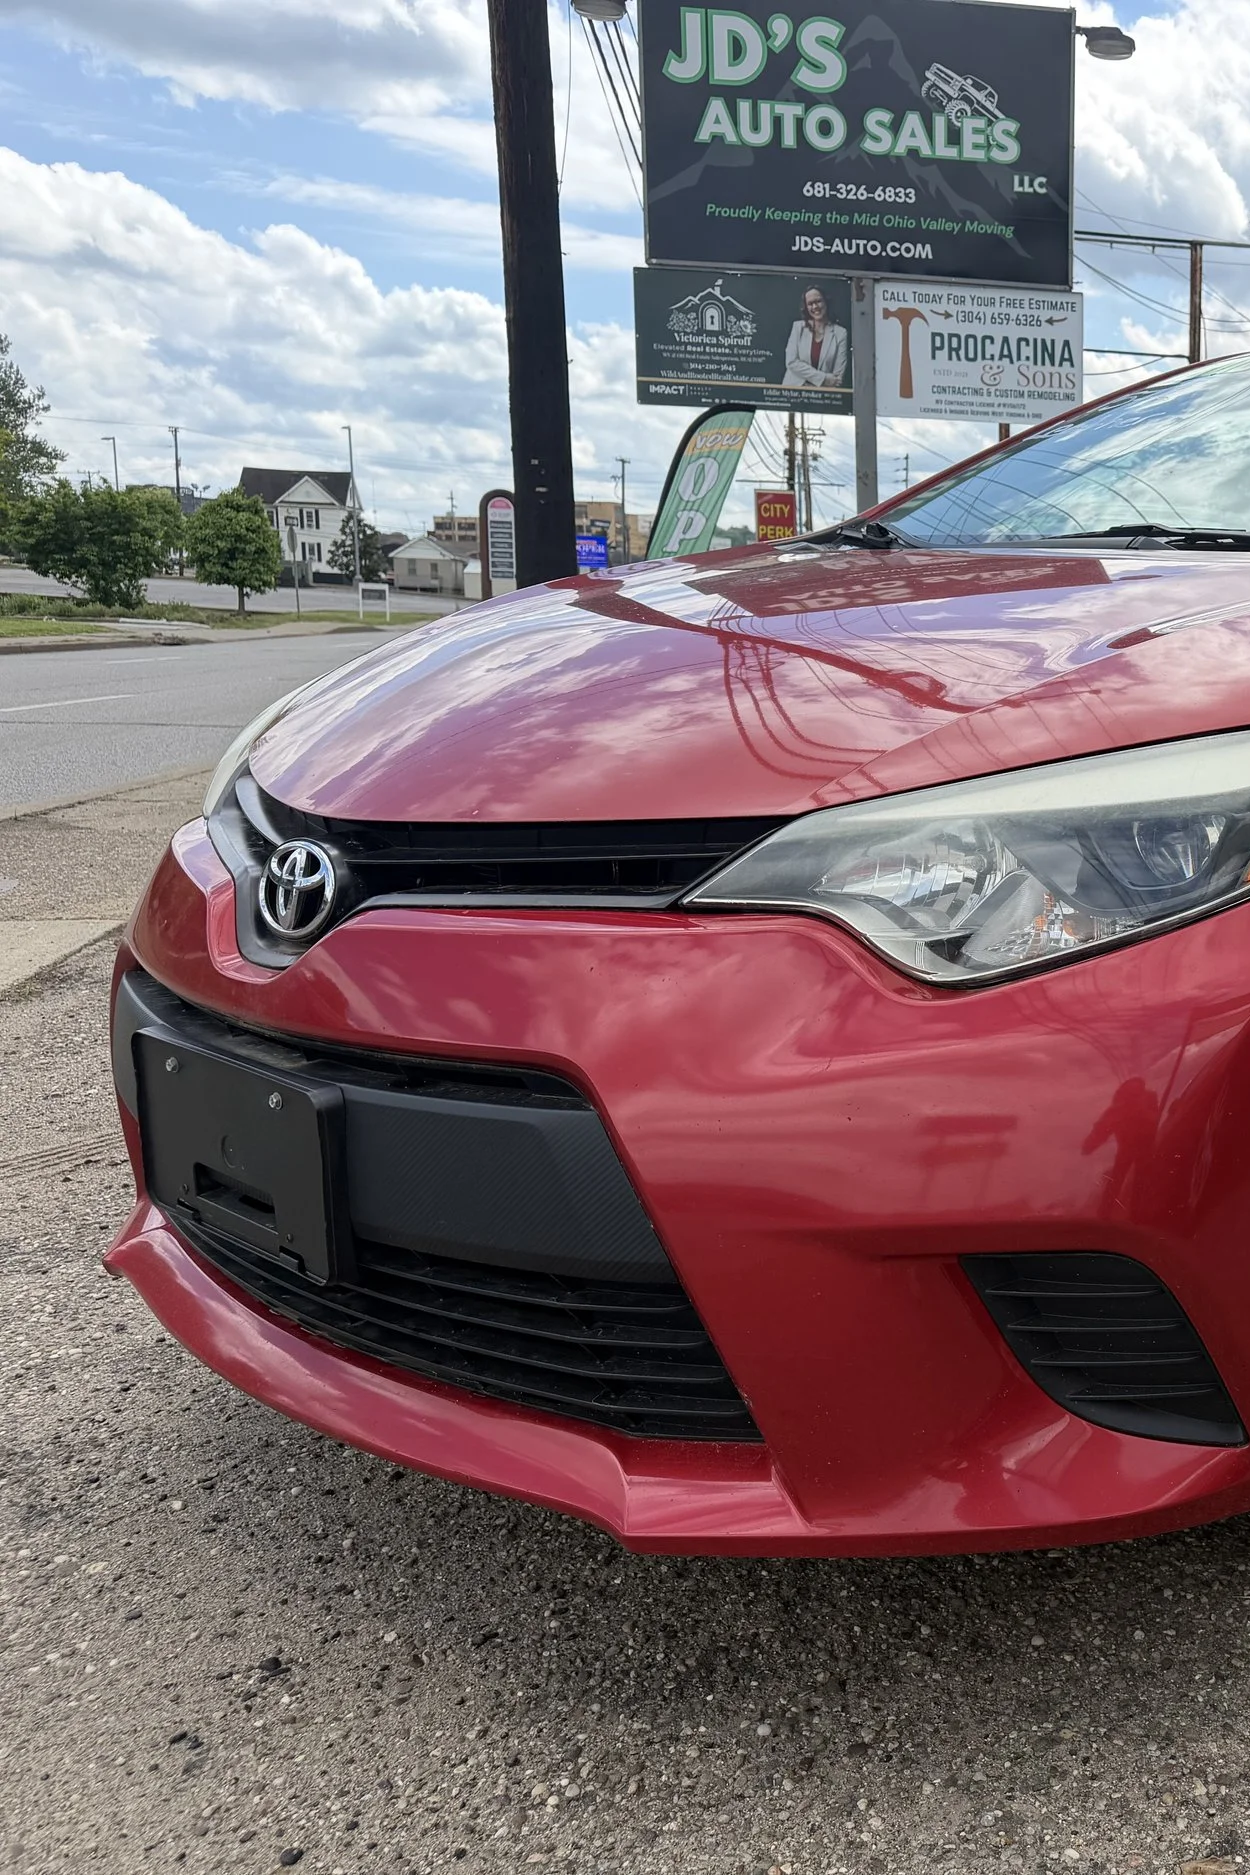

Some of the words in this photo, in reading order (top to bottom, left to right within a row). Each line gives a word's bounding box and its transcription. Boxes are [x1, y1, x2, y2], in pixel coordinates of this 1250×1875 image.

[662, 6, 847, 94] JD'S
[694, 97, 847, 152] AUTO
[859, 107, 1021, 164] SALES
[802, 181, 916, 204] 681-326-6833
[1013, 174, 1048, 194] LLC
[706, 203, 761, 222] Proudly
[764, 207, 822, 226] Keeping
[826, 211, 849, 225] the
[853, 212, 880, 227] Mid
[883, 214, 916, 229] Ohio
[920, 217, 961, 235] Valley
[965, 220, 1015, 239] Moving
[791, 235, 934, 260] JDS-AUTO.COM
[882, 289, 909, 303] CALL
[912, 291, 944, 305] TODAY
[946, 293, 966, 306] FOR
[969, 294, 996, 308] YOUR
[999, 296, 1025, 309] FREE
[1028, 298, 1077, 313] ESTIMATE
[955, 310, 987, 325] (304)
[653, 343, 685, 351] Elevated
[718, 335, 753, 347] Spiroff
[930, 331, 1075, 369] PROCACINA
[980, 363, 1005, 387] &
[1016, 363, 1076, 390] Sons
[649, 384, 684, 395] IMPACT
[931, 385, 984, 397] CONTRACTING
[986, 388, 992, 397] &
[994, 389, 1025, 399] CUSTOM
[1027, 390, 1076, 402] REMODELING
[761, 502, 790, 518] CITY
[759, 525, 794, 540] PERK
